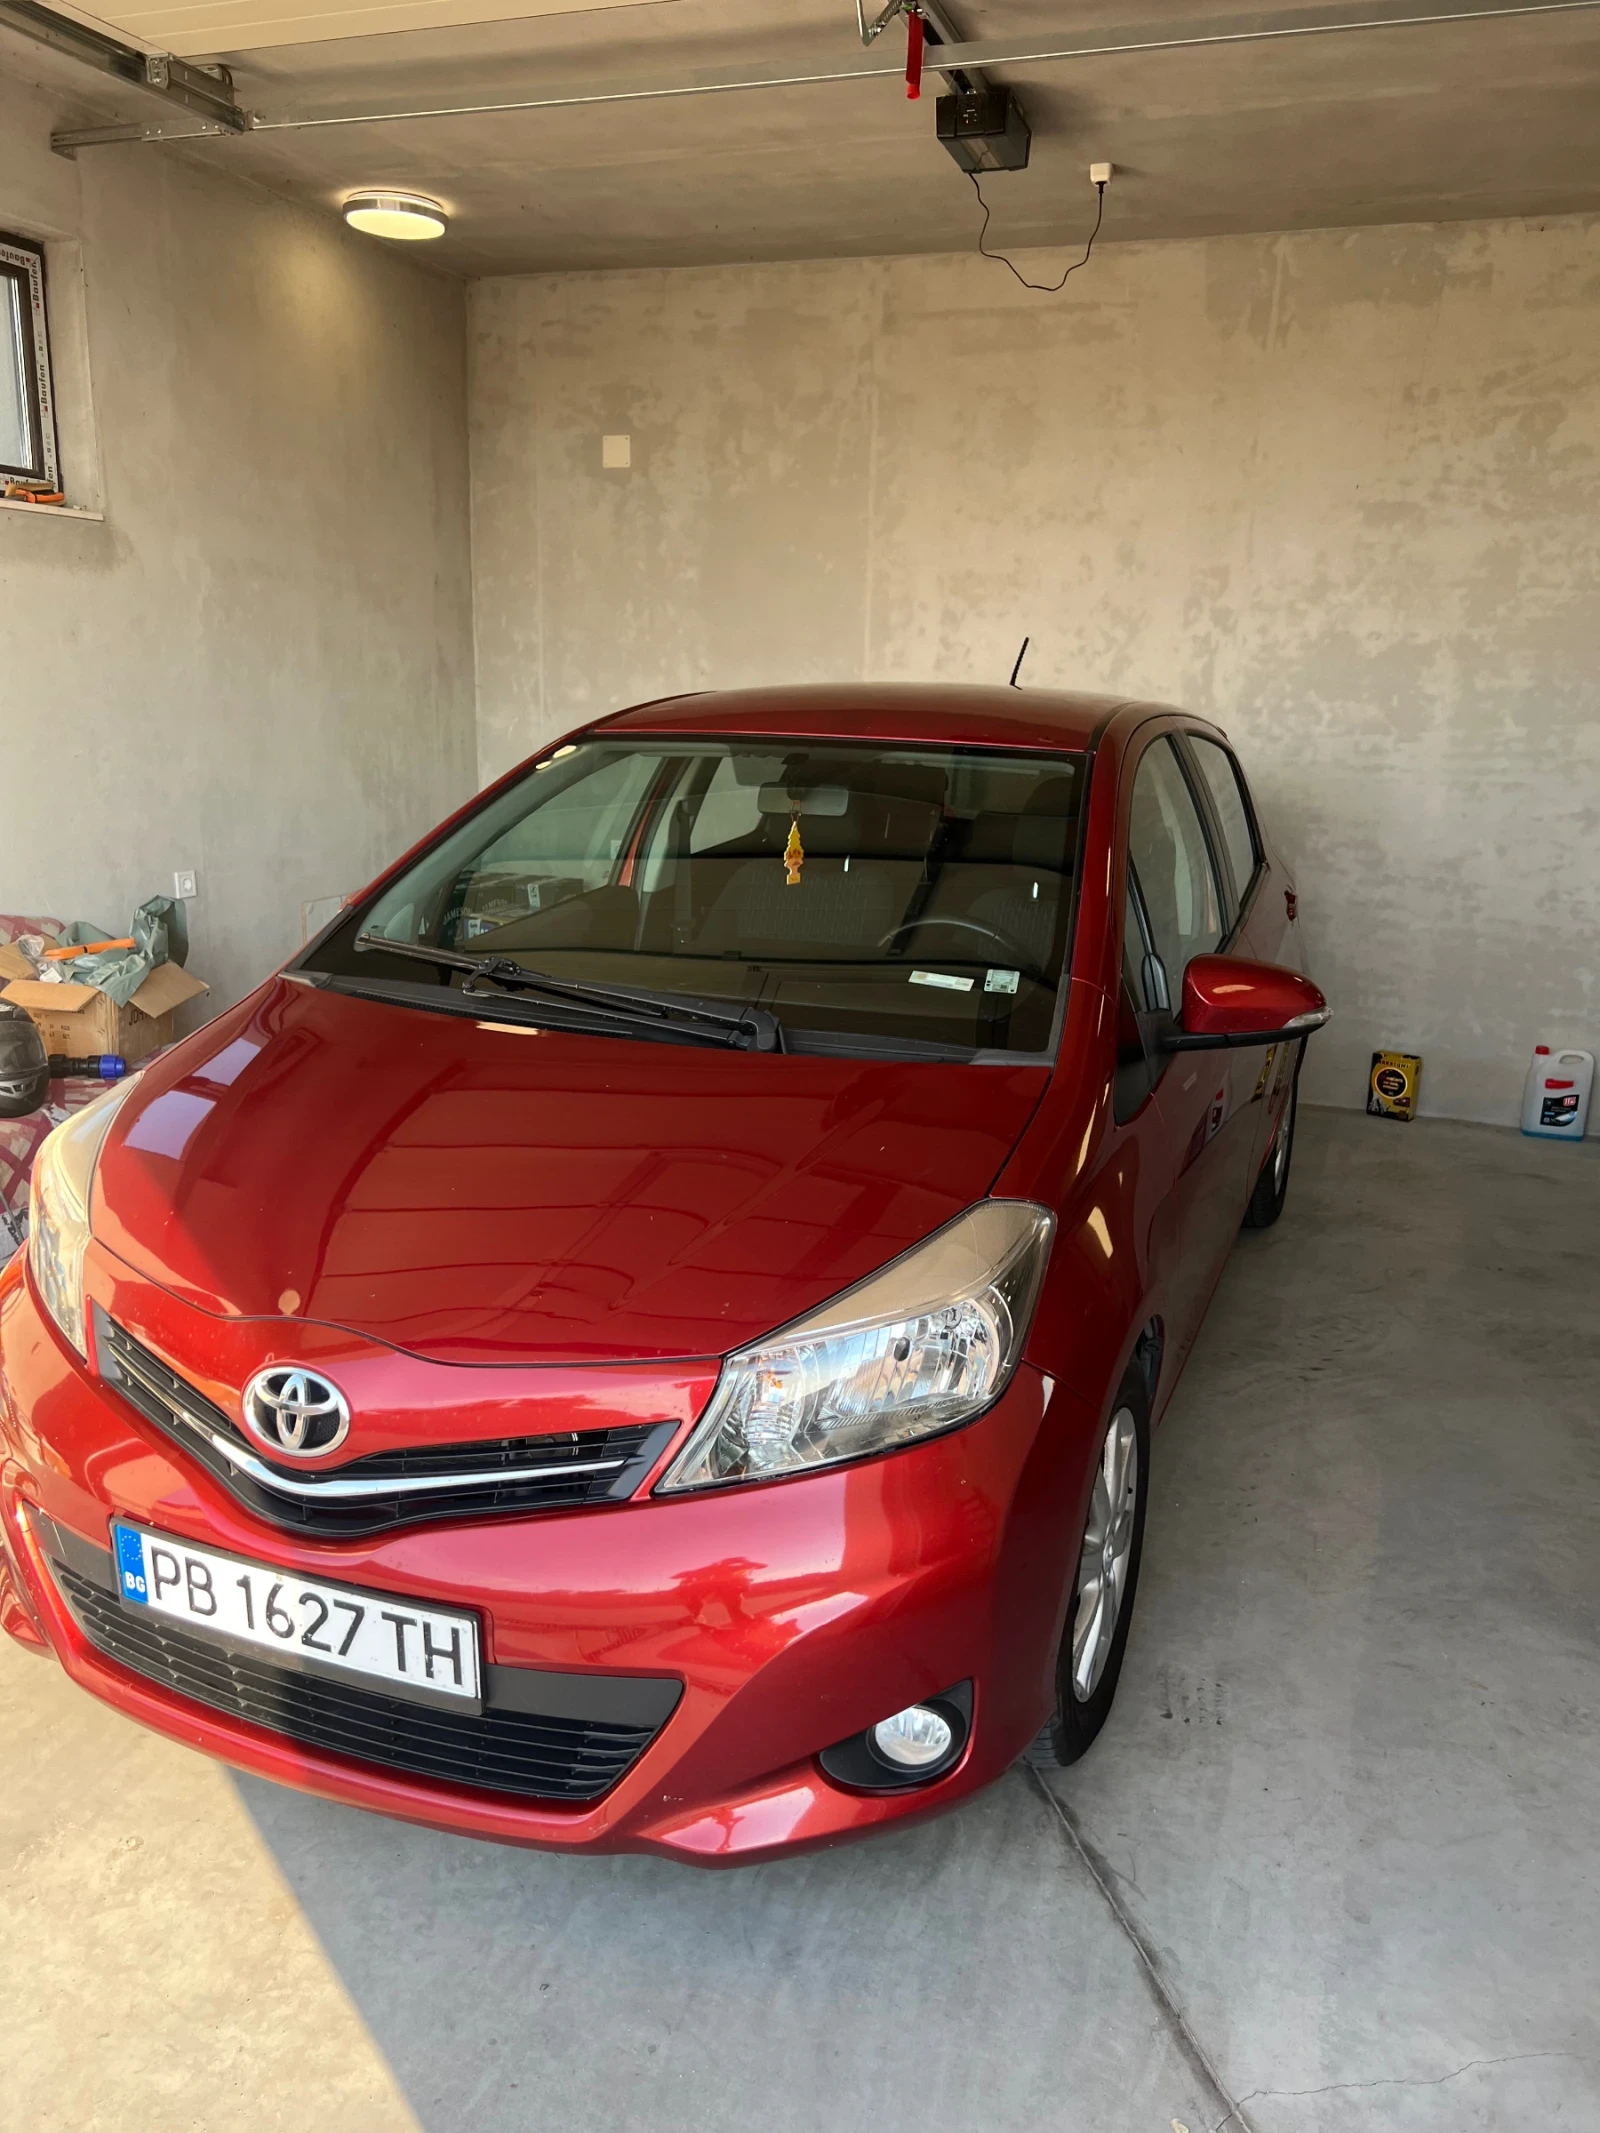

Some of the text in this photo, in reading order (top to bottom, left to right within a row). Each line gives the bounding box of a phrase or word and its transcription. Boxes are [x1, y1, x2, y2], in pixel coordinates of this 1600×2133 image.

[1, 249, 26, 266] Baufe
[38, 364, 48, 405] Baufen
[125, 1570, 146, 1593] BG
[150, 1545, 464, 1686] PB 1627 TH
